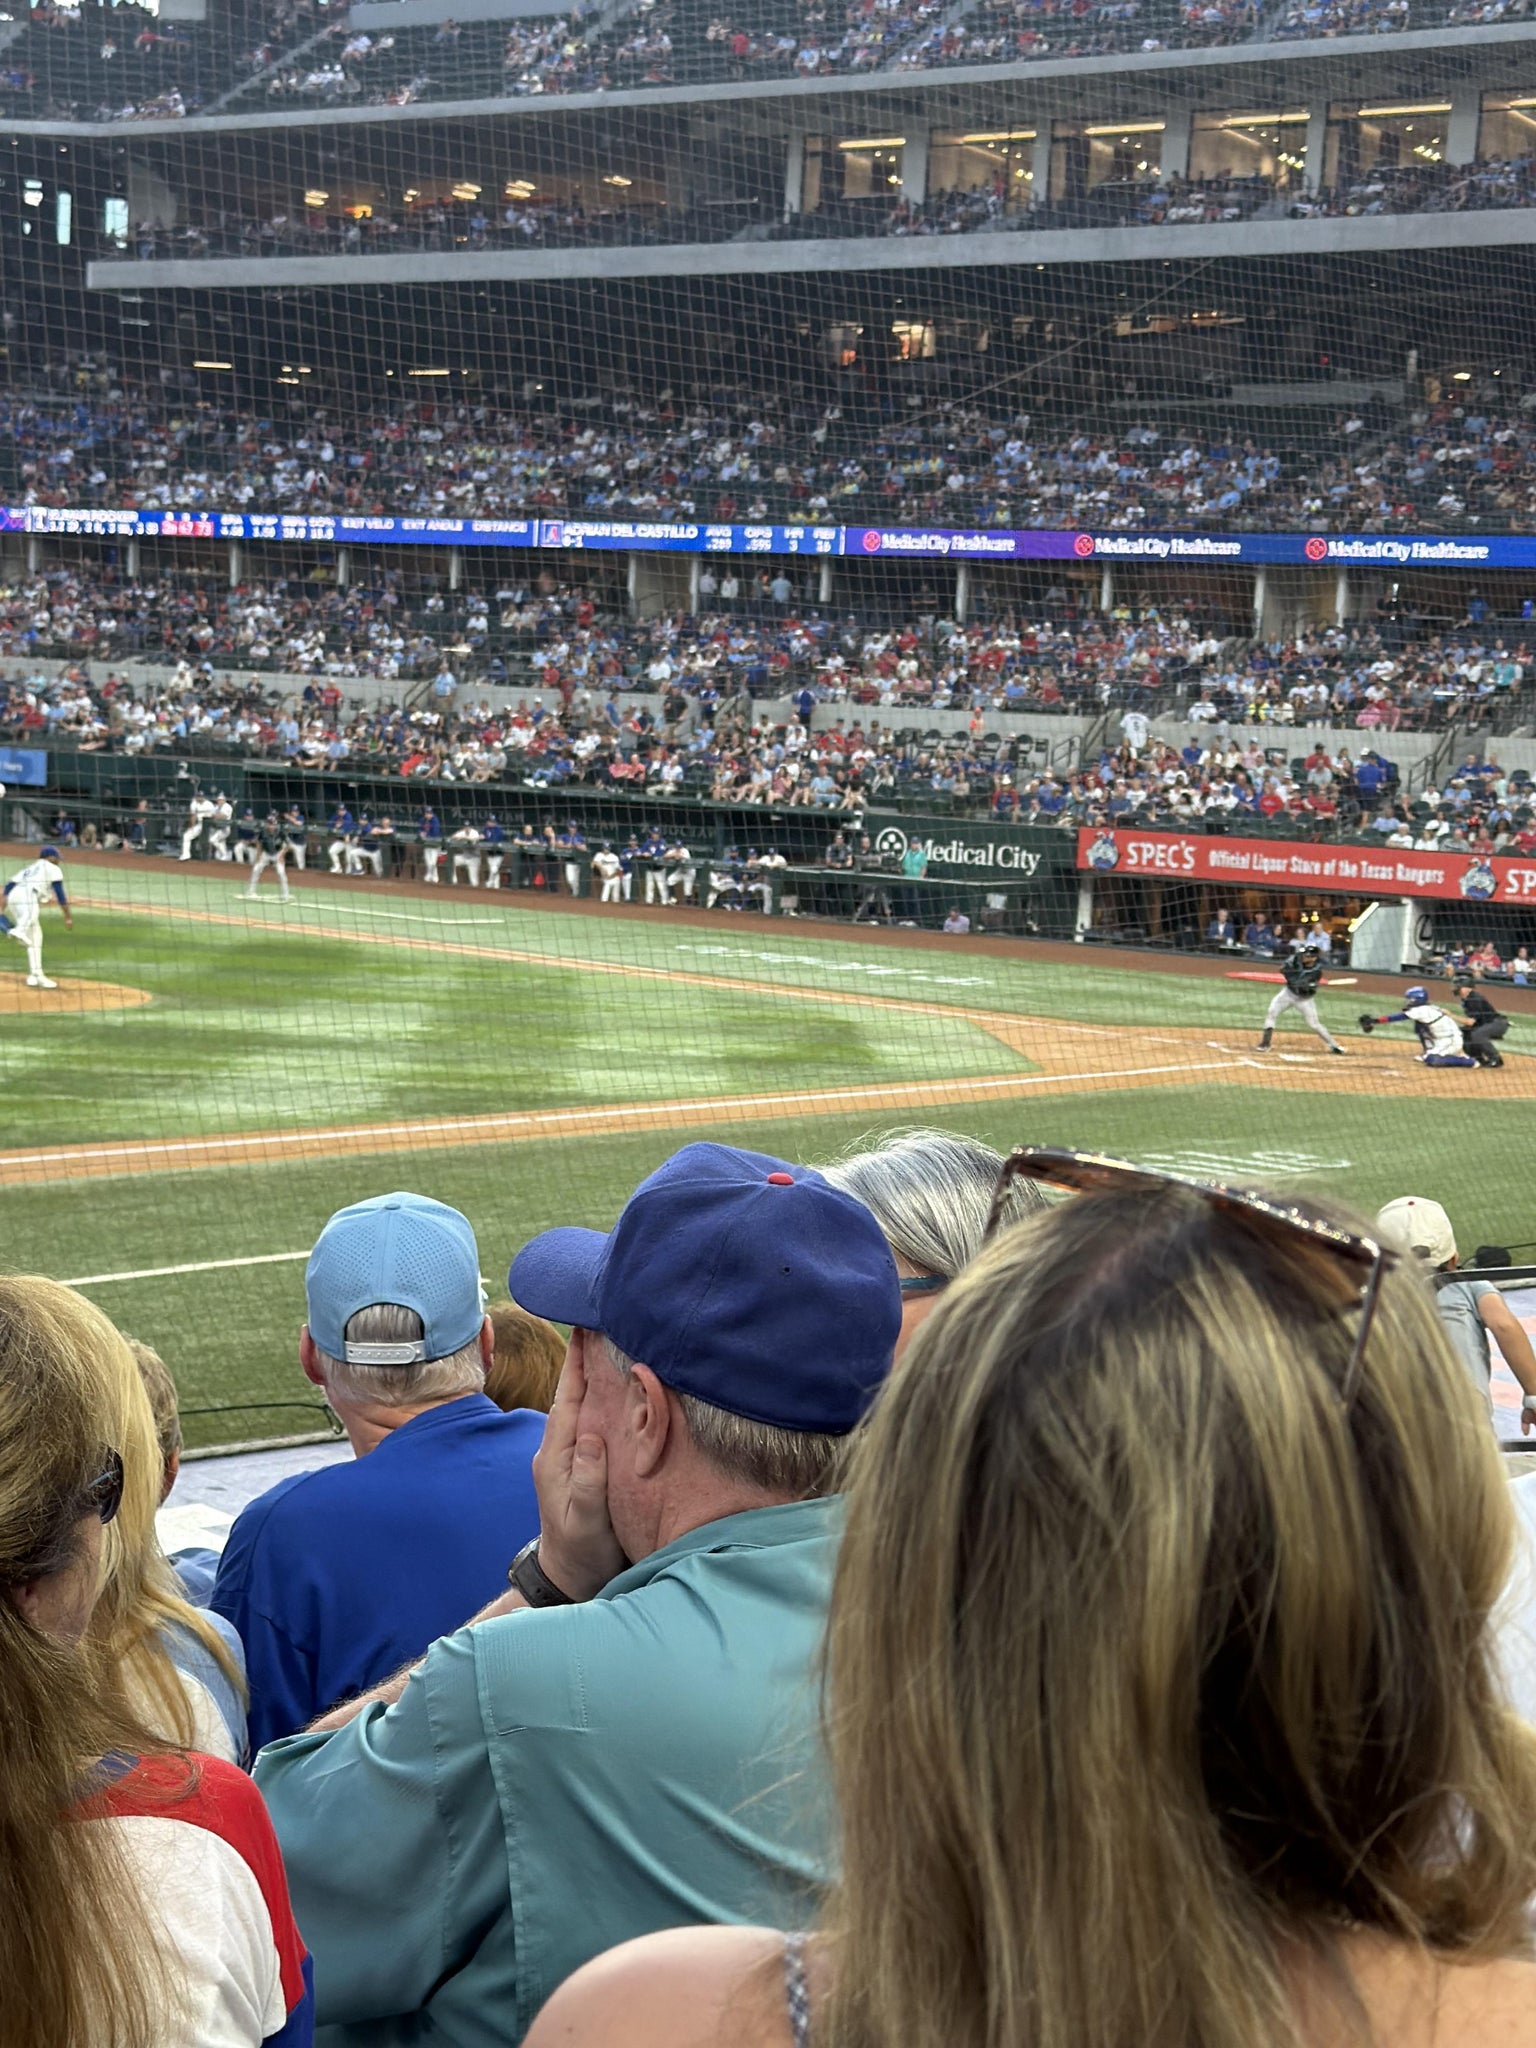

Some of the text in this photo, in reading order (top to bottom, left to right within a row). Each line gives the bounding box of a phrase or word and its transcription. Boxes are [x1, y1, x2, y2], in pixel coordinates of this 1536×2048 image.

[611, 523, 636, 538] DEL
[637, 523, 699, 539] CASTILLO
[881, 533, 1015, 554] Medical City Healthcare
[1094, 537, 1241, 558] Medical City Healthcare
[1328, 540, 1489, 561] Medical City Healthcare
[996, 844, 1042, 876] City
[1126, 840, 1197, 870] SPEC'S
[1208, 850, 1445, 887] Official Liquor Store of the Texas Rangers
